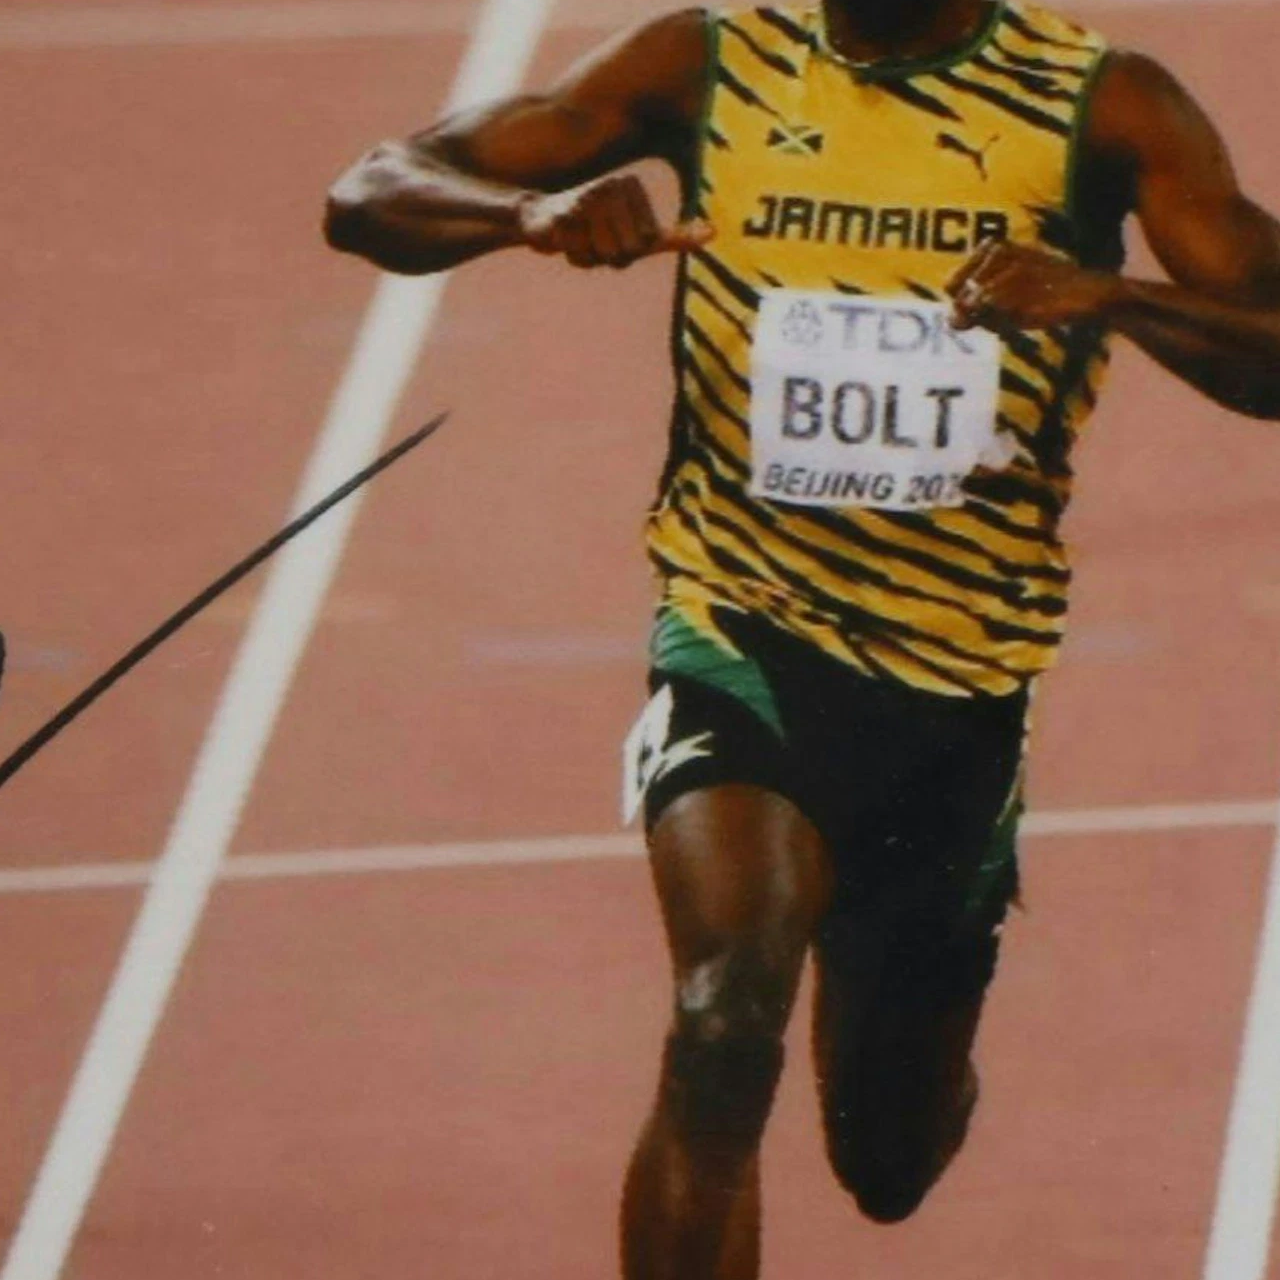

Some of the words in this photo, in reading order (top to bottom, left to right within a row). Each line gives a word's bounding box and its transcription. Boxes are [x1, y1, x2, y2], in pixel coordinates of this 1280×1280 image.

[828, 303, 976, 357] TDK
[781, 376, 965, 449] BOLT
[763, 462, 898, 503] BEIJING
